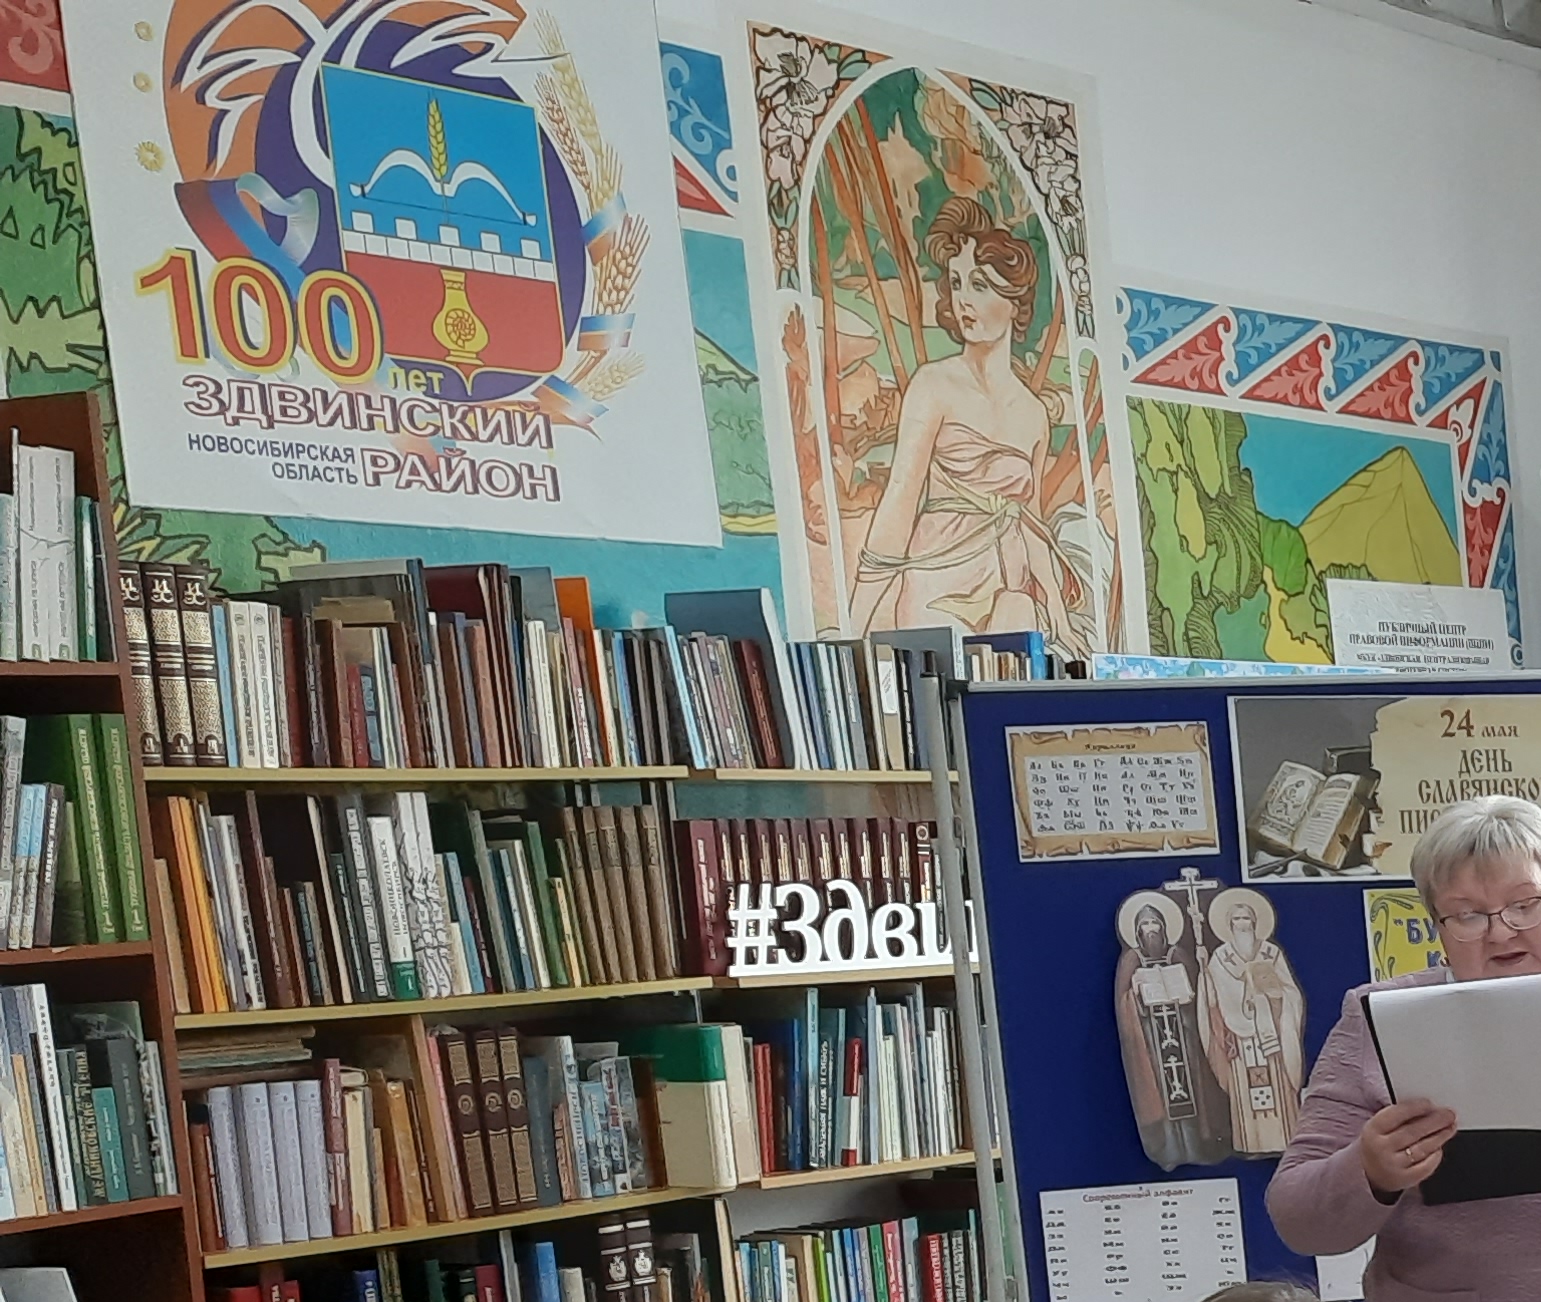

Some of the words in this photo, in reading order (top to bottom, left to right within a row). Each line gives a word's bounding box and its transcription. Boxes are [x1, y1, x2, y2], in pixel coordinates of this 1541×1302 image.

[134, 247, 384, 384] 100
[387, 364, 446, 396] лет
[182, 375, 555, 450] ЗДВИНСКИЙ
[187, 433, 357, 464] НОВОСИБИРСКАЯ
[271, 462, 359, 485] ОБЛАСТЬ
[359, 446, 561, 502] РАЙОН
[1440, 709, 1475, 739] 24
[1457, 747, 1513, 777] ДЕНЬ
